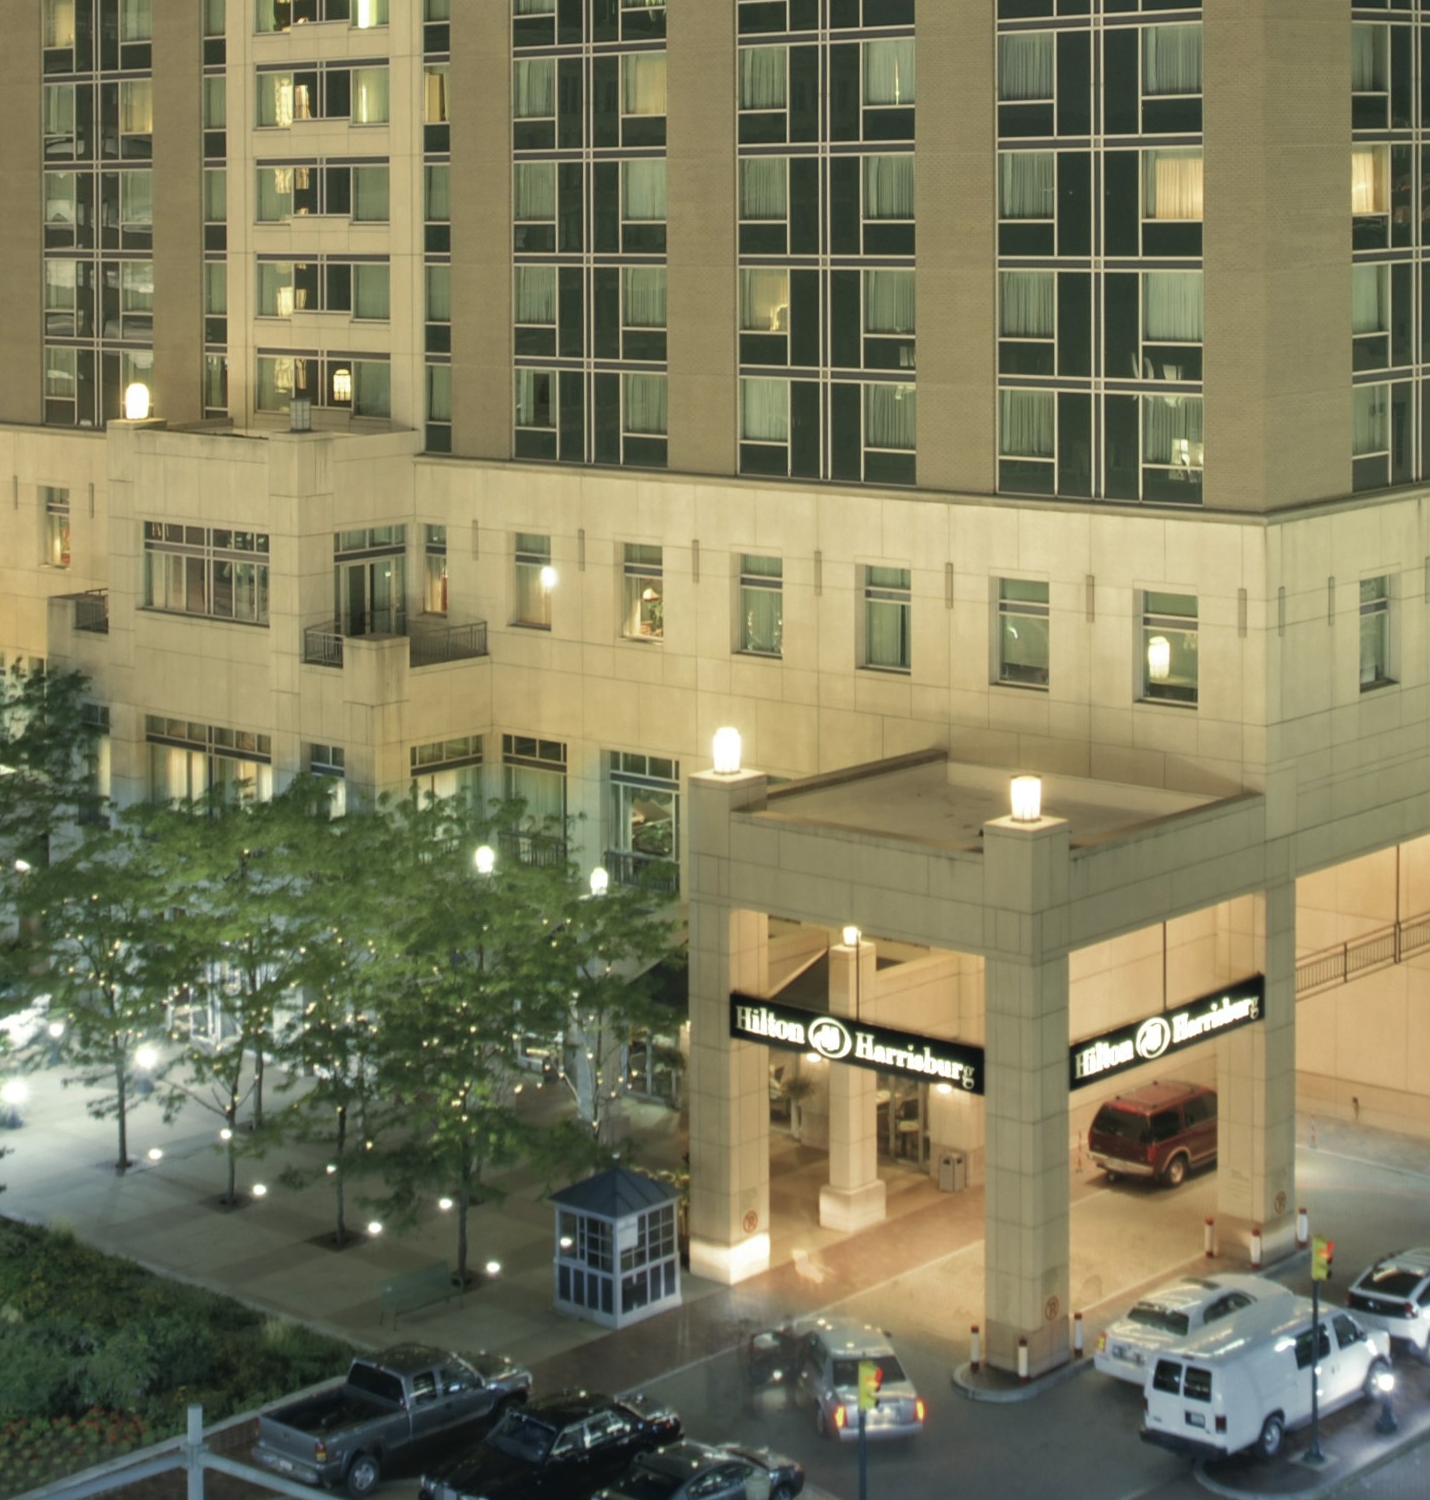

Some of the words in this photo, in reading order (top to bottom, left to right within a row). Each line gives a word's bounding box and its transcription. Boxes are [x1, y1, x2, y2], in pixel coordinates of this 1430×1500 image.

[736, 1006, 805, 1044] Hilton
[855, 1032, 975, 1089] Harrisburg
[1075, 1039, 1134, 1079] Hilton
[1172, 996, 1259, 1043] Harrisburg
